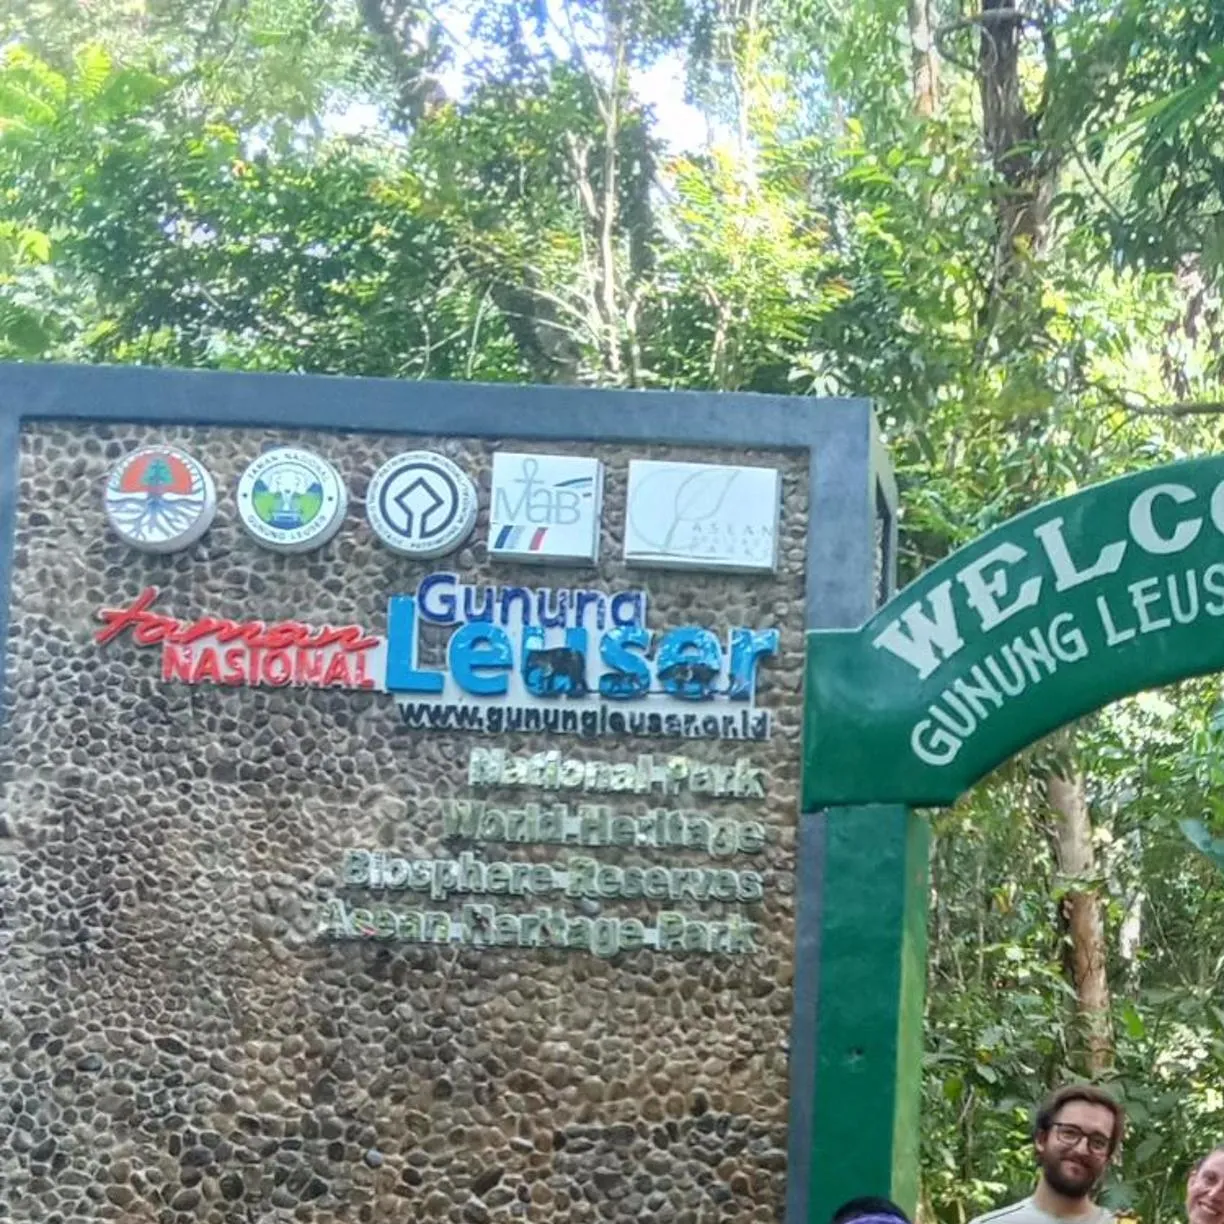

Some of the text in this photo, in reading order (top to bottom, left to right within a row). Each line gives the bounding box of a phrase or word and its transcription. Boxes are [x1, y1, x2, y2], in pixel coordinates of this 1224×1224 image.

[161, 643, 375, 688] NASIONAL
[386, 594, 779, 700] Leuser
[911, 611, 1090, 767] GUNUNG
